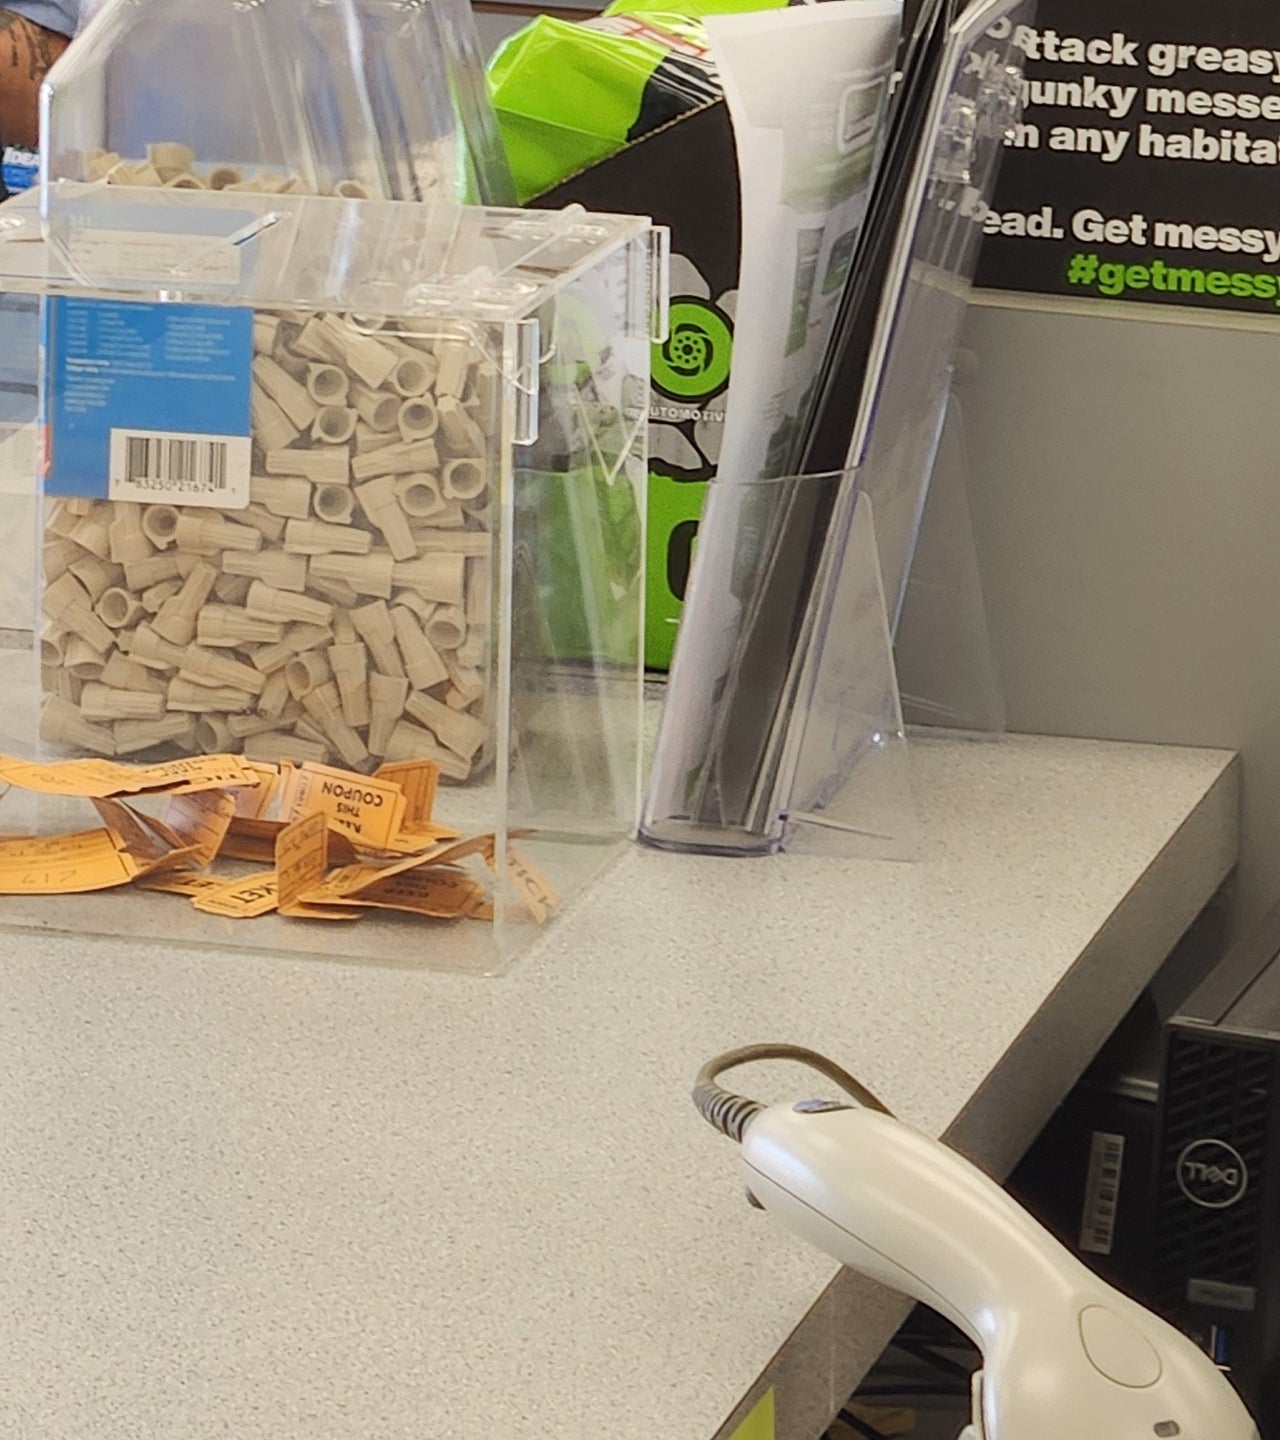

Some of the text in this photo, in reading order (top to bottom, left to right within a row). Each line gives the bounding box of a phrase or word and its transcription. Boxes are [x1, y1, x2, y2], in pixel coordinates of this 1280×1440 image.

[1048, 123, 1131, 163] any
[1138, 123, 1280, 166] habita
[1071, 208, 1148, 246] Get
[650, 406, 725, 423] UTOMOTIV
[320, 780, 385, 808] COUPON
[336, 801, 361, 819] THIS
[1183, 1161, 1238, 1186] DELL
